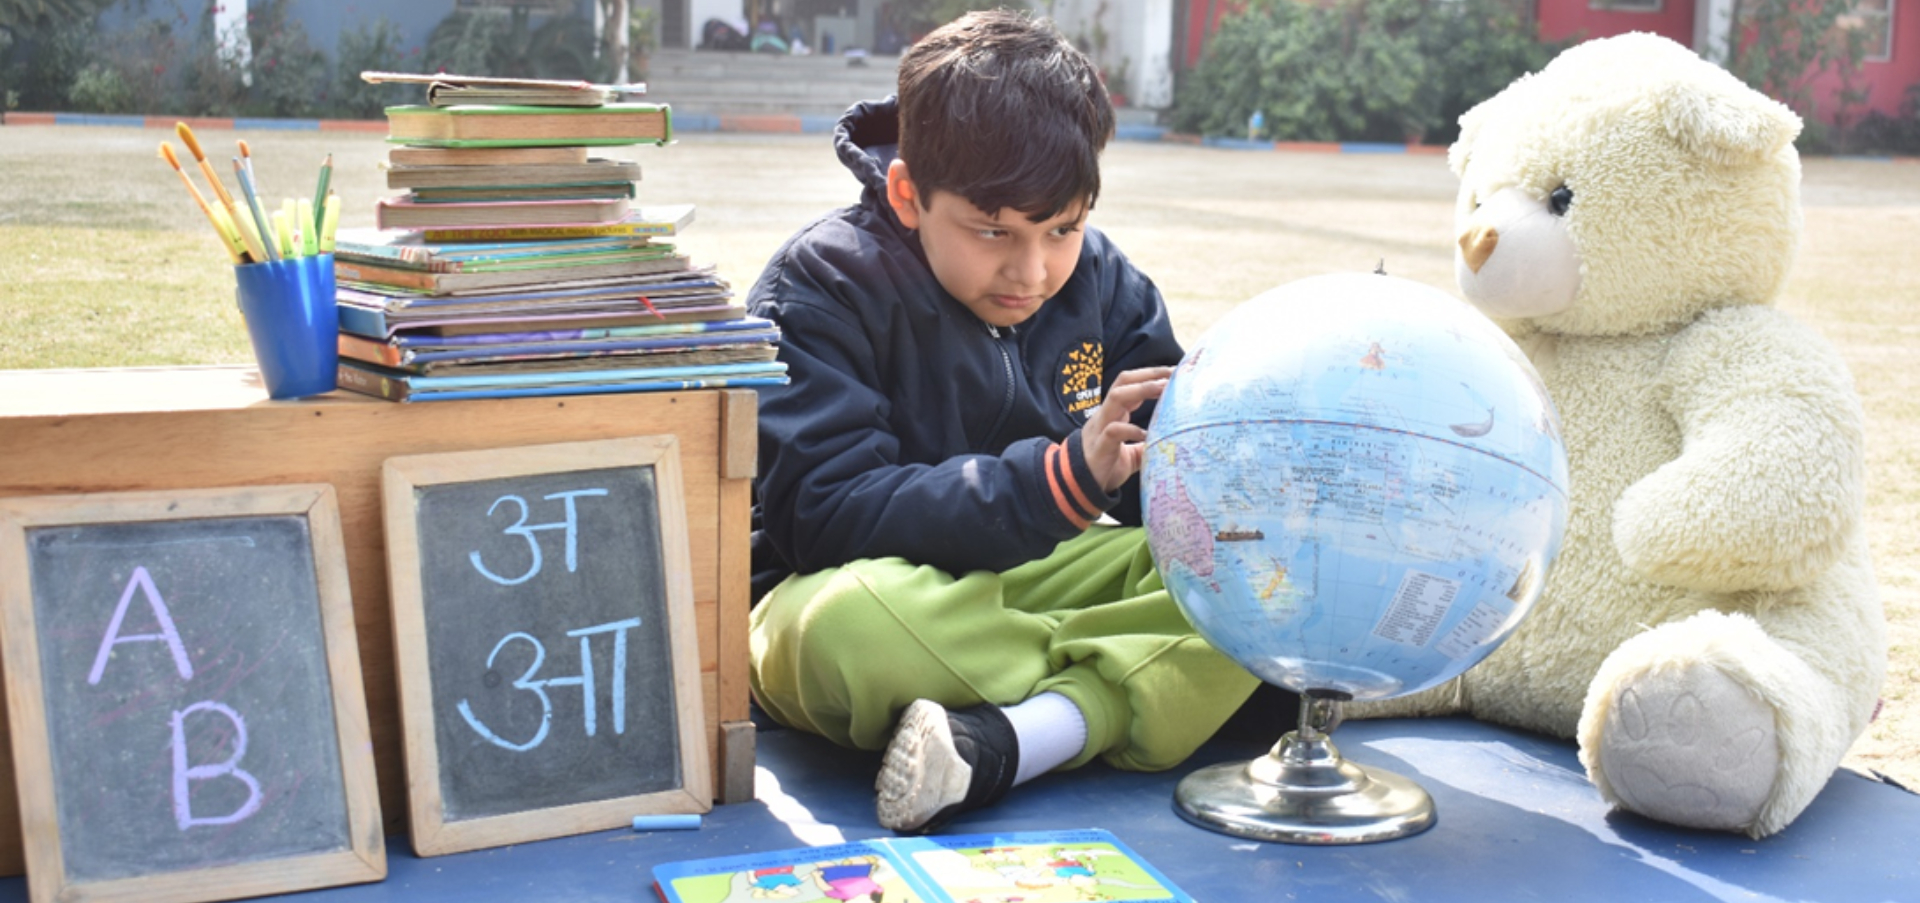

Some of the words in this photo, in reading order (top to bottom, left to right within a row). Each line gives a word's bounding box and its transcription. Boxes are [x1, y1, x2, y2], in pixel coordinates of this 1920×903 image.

[469, 488, 608, 585] अ
[87, 566, 193, 685] A
[457, 617, 641, 752] आ
[169, 701, 263, 831] B
